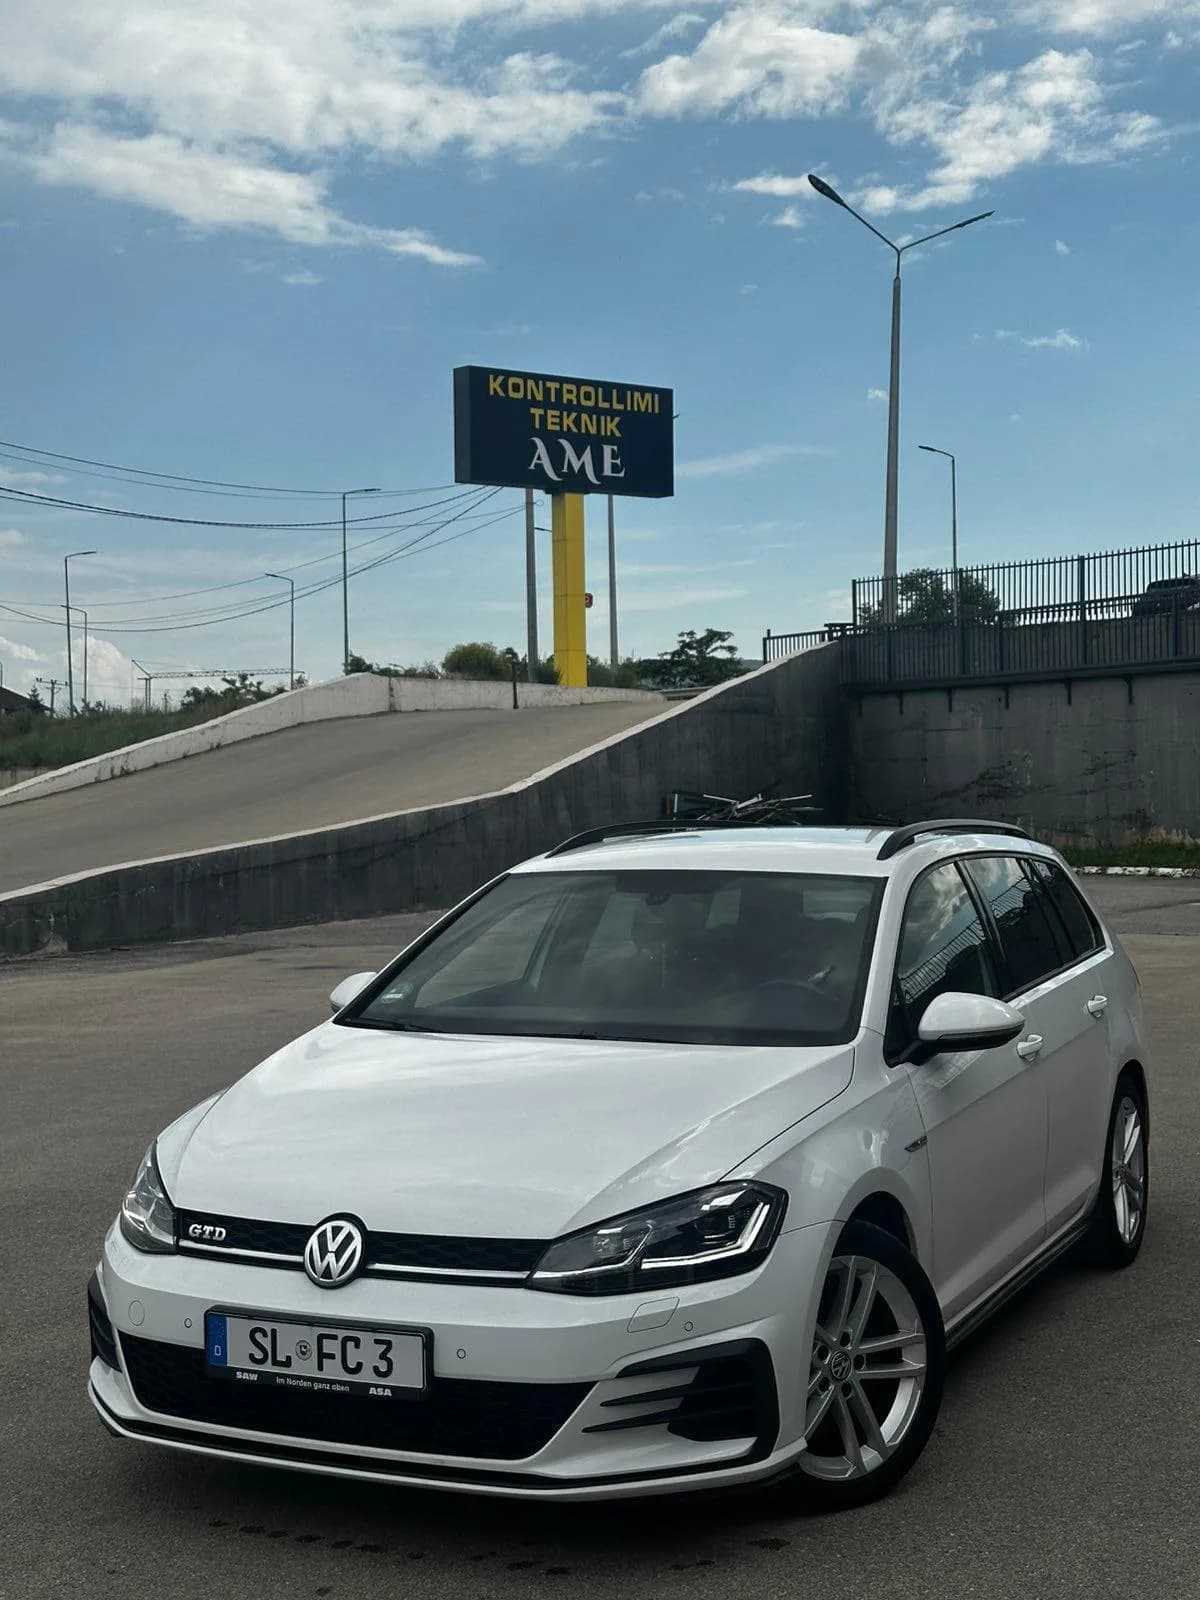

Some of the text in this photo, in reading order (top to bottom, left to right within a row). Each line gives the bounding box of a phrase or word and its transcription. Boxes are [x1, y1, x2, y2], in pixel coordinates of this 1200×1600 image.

[488, 374, 660, 414] KONTROLLIMI
[530, 407, 622, 437] TEKNIK
[528, 437, 626, 485] AME
[188, 1223, 227, 1241] GTD
[214, 1345, 222, 1356] D
[248, 1326, 394, 1378] SL FC 3
[235, 1371, 258, 1381] SAW
[276, 1376, 350, 1392] Im Norden ganz oben
[368, 1387, 393, 1396] ASA
